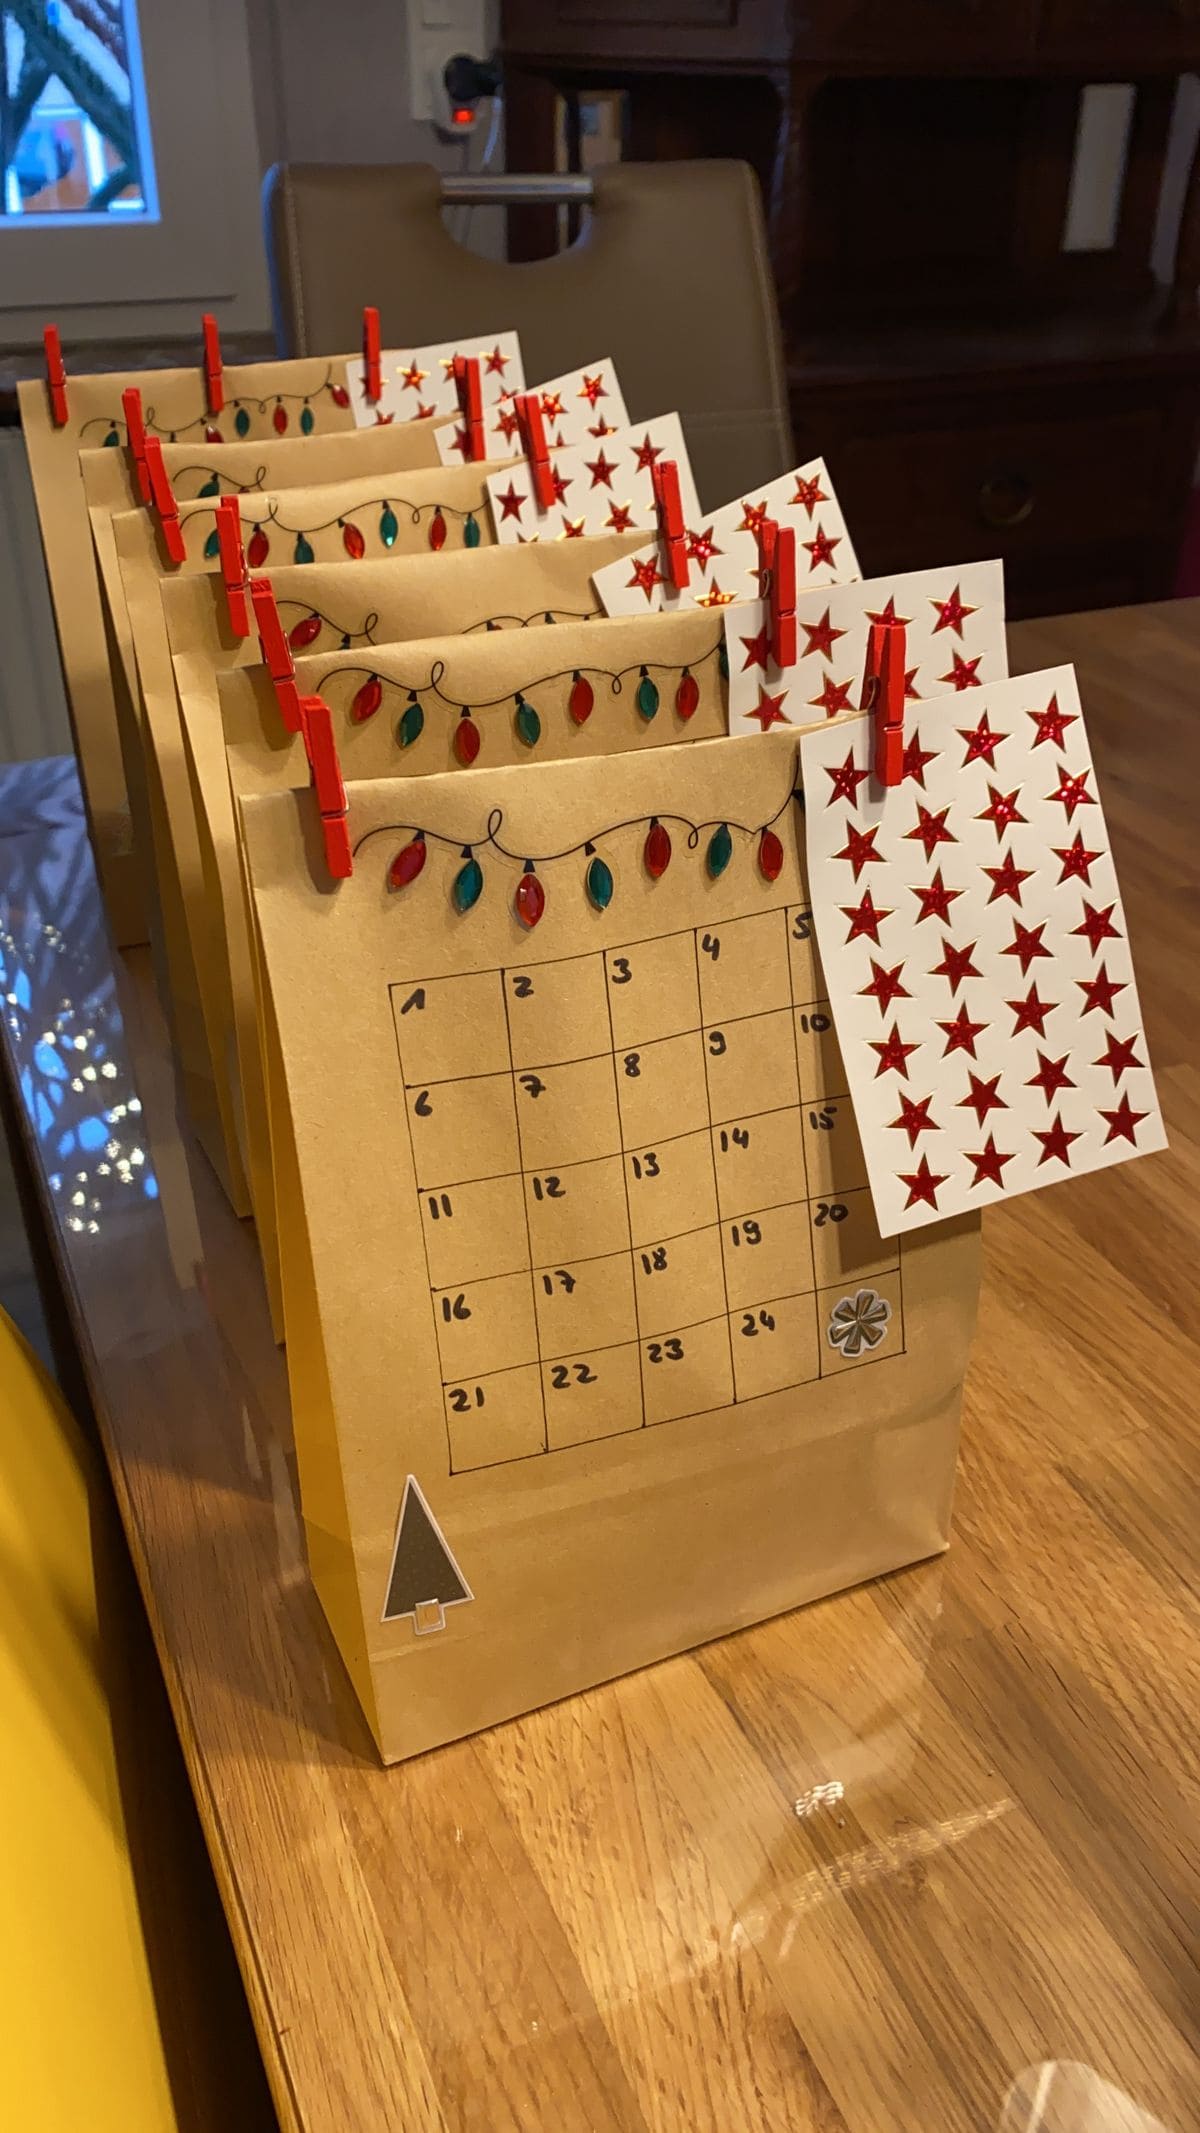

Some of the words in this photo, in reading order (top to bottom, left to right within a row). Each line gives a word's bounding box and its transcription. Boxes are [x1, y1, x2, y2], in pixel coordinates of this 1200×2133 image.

[400, 988, 426, 1015] 1
[512, 975, 535, 999] 2
[611, 957, 633, 985] 3
[701, 933, 721, 962] 4
[792, 911, 813, 940] 5
[414, 1090, 433, 1117] 6
[518, 1074, 547, 1099] 7
[623, 1052, 641, 1078] 8
[708, 1030, 727, 1057] 9
[801, 1013, 831, 1033] 10
[428, 1193, 453, 1220] 11
[532, 1176, 567, 1201] 12
[631, 1152, 661, 1180] 13
[720, 1127, 750, 1153] 14
[810, 1106, 838, 1131] 15
[441, 1293, 472, 1323] 16
[542, 1269, 577, 1296] 17
[640, 1246, 668, 1276] 18
[731, 1219, 762, 1247] 19
[814, 1203, 849, 1227] 20
[448, 1386, 485, 1413] 21
[550, 1363, 598, 1390] 22
[647, 1337, 685, 1364] 23
[741, 1309, 776, 1337] 24
